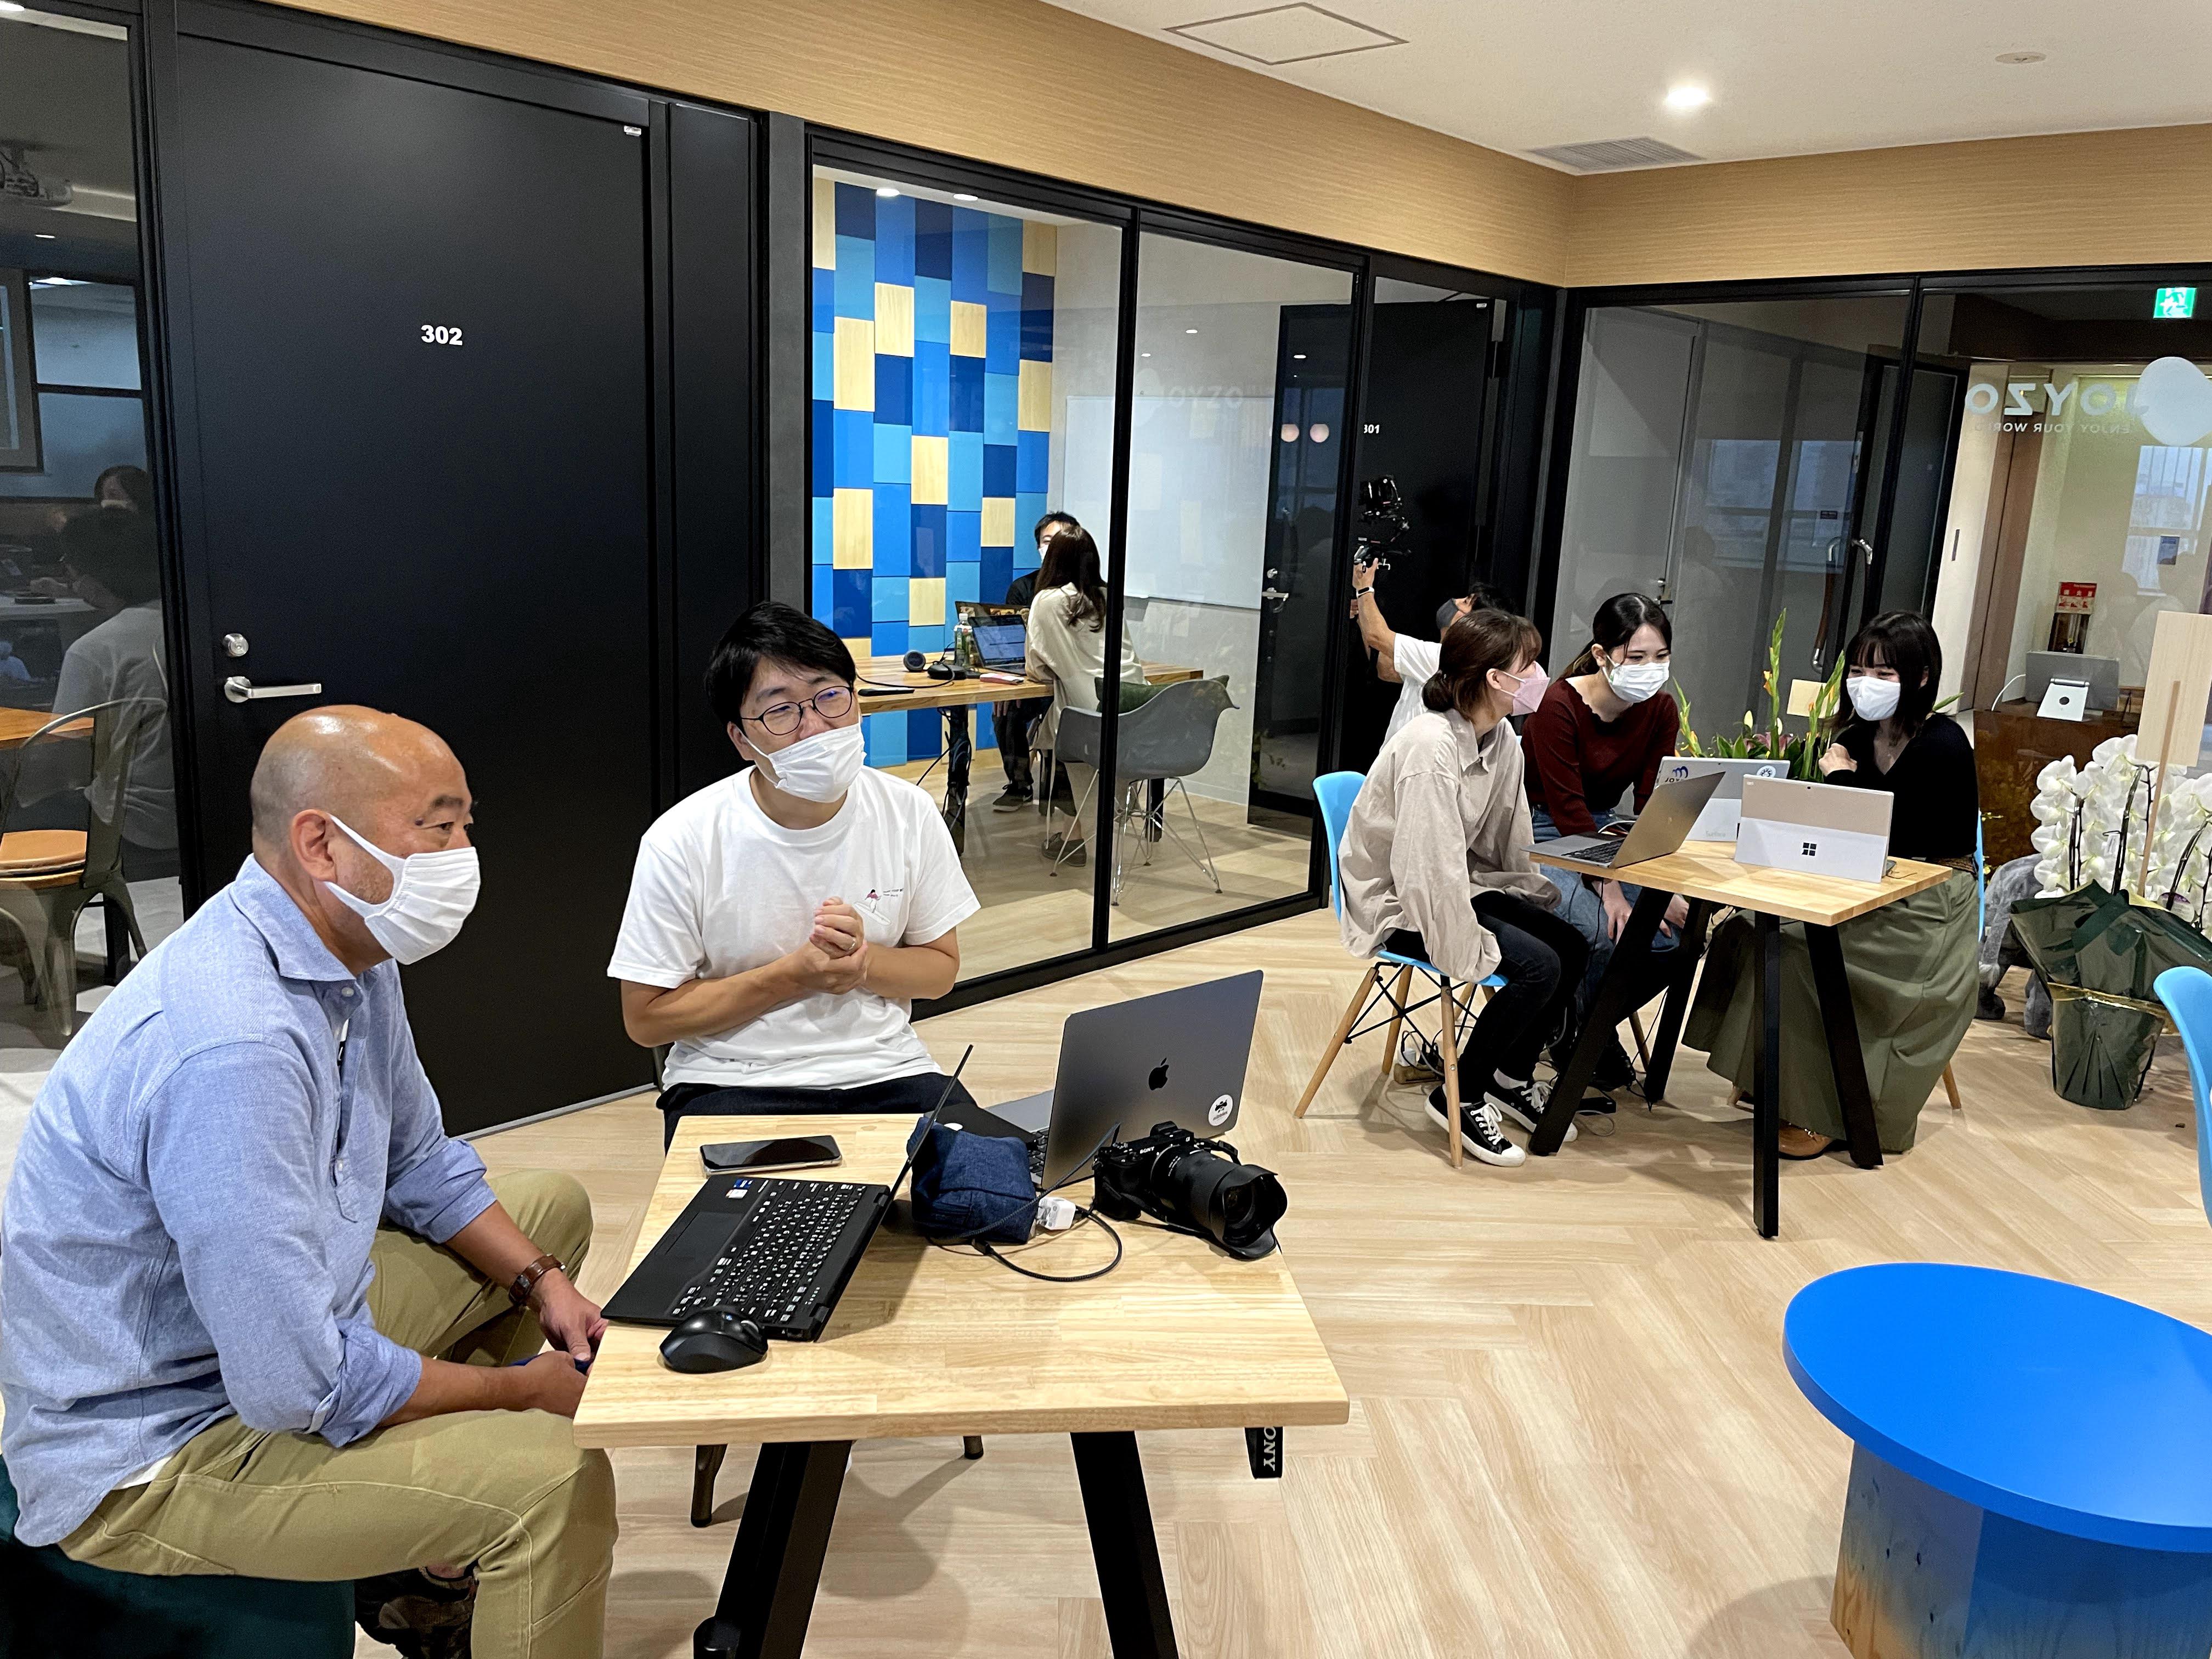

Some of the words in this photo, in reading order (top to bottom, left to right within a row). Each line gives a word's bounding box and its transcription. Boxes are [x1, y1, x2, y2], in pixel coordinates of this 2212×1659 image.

[421, 325, 462, 346] 302
[1363, 424, 1380, 433] 301
[1139, 1146, 1155, 1154] SONY
[1263, 1426, 1276, 1471] ONY
